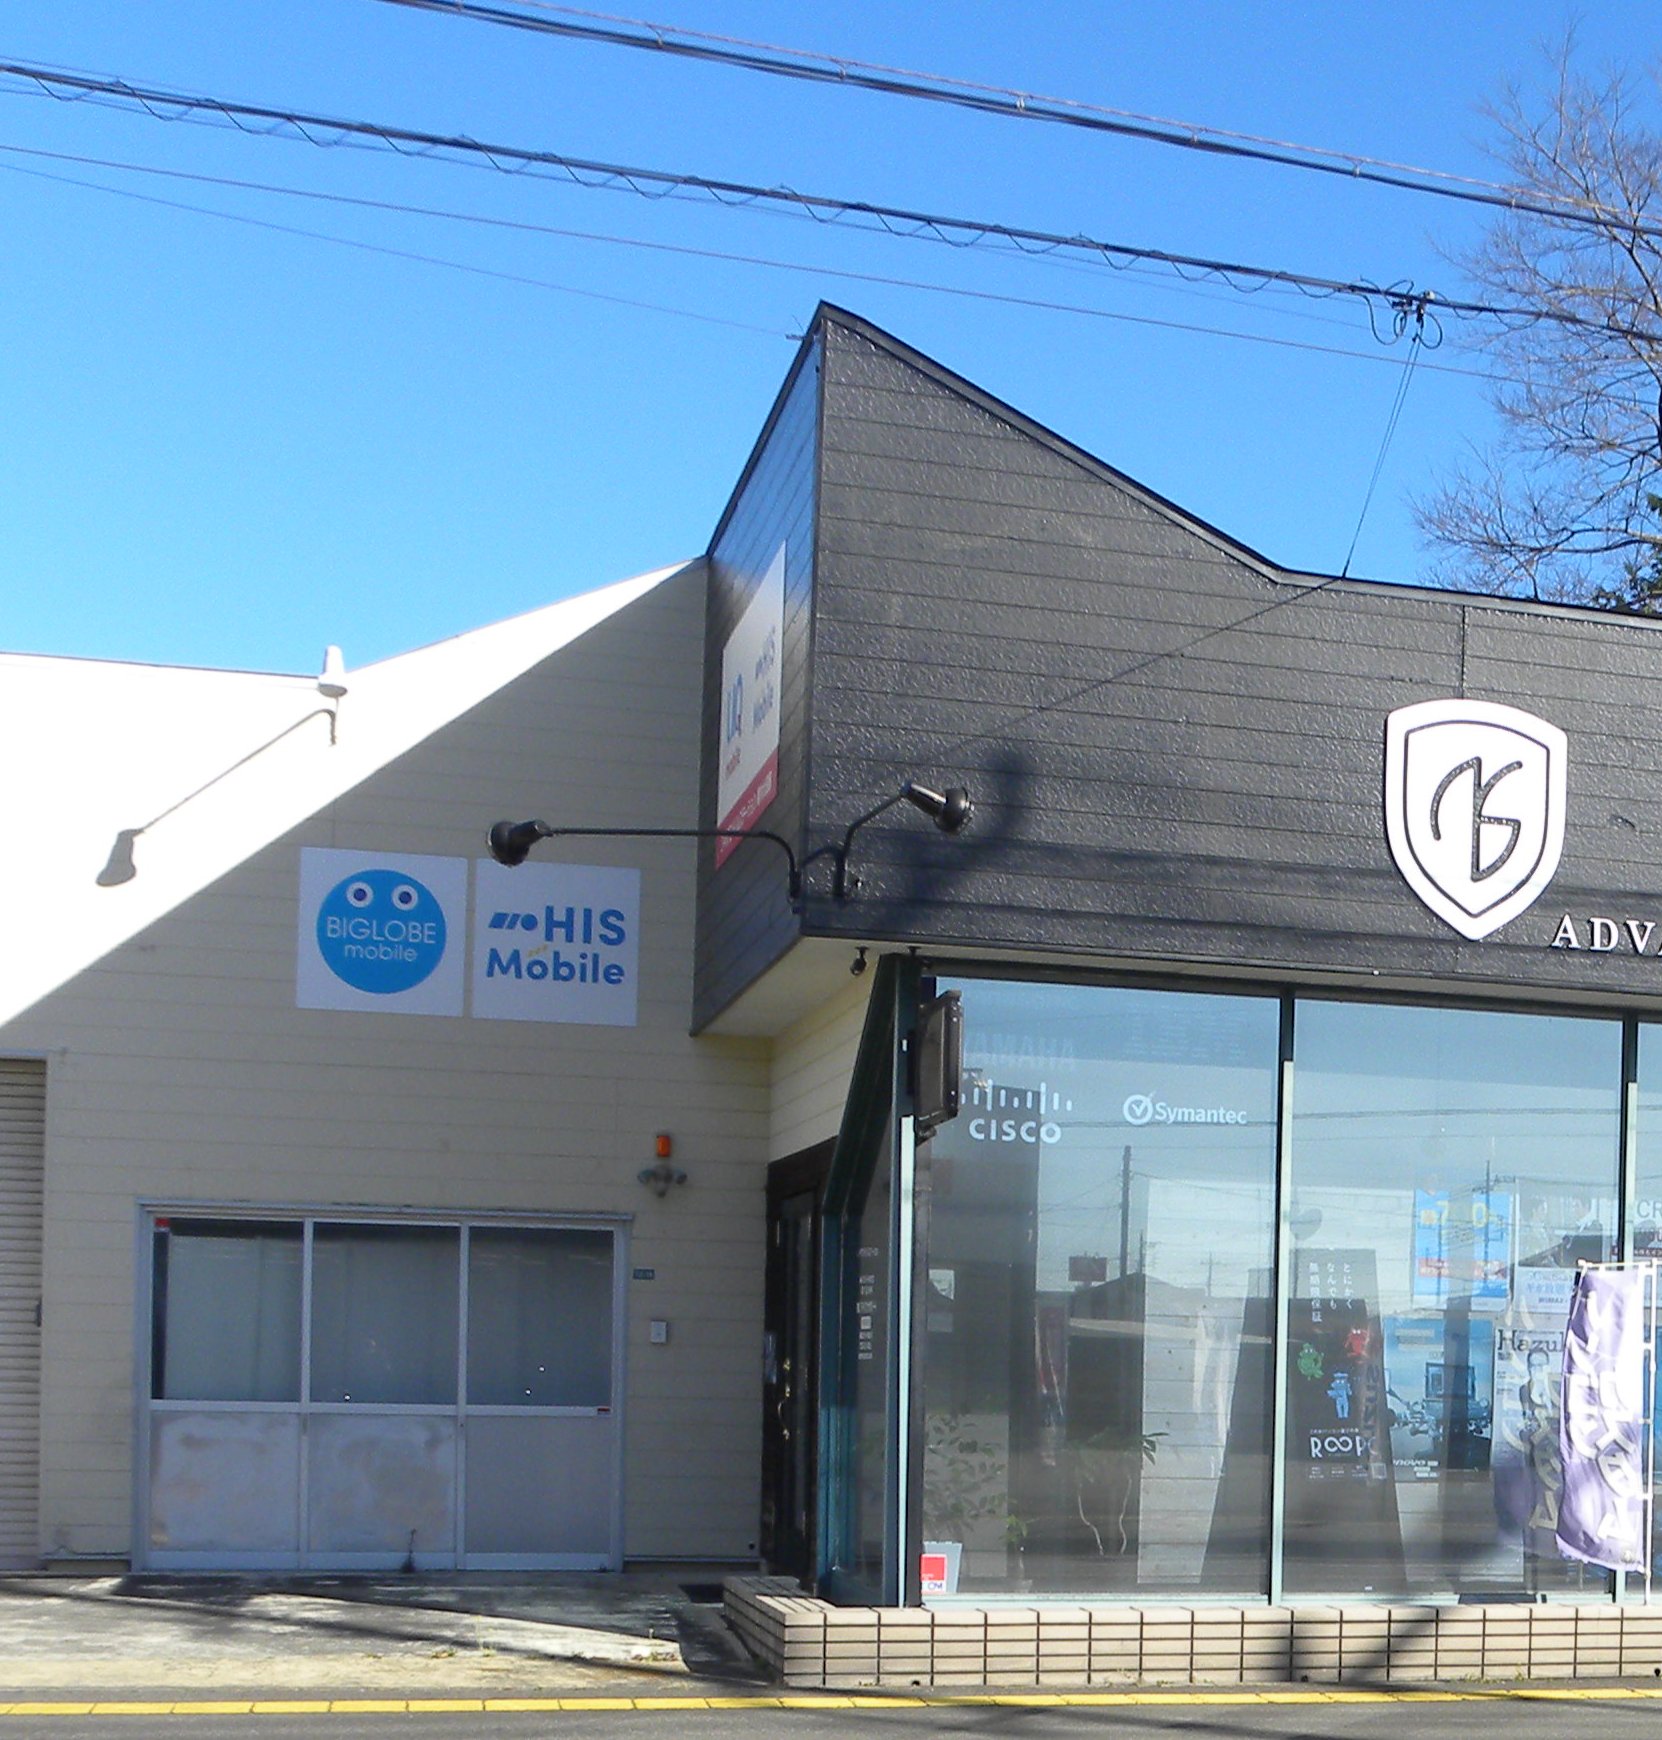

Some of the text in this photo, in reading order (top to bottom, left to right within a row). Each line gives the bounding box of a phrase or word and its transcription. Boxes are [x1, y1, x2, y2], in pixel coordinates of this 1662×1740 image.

[327, 916, 436, 945] BIGLOBE
[545, 906, 626, 946] HIS
[344, 942, 418, 962] mobile
[486, 948, 625, 985] Mobile
[1155, 1101, 1248, 1126] Symantec
[1498, 1328, 1565, 1352] Hazu
